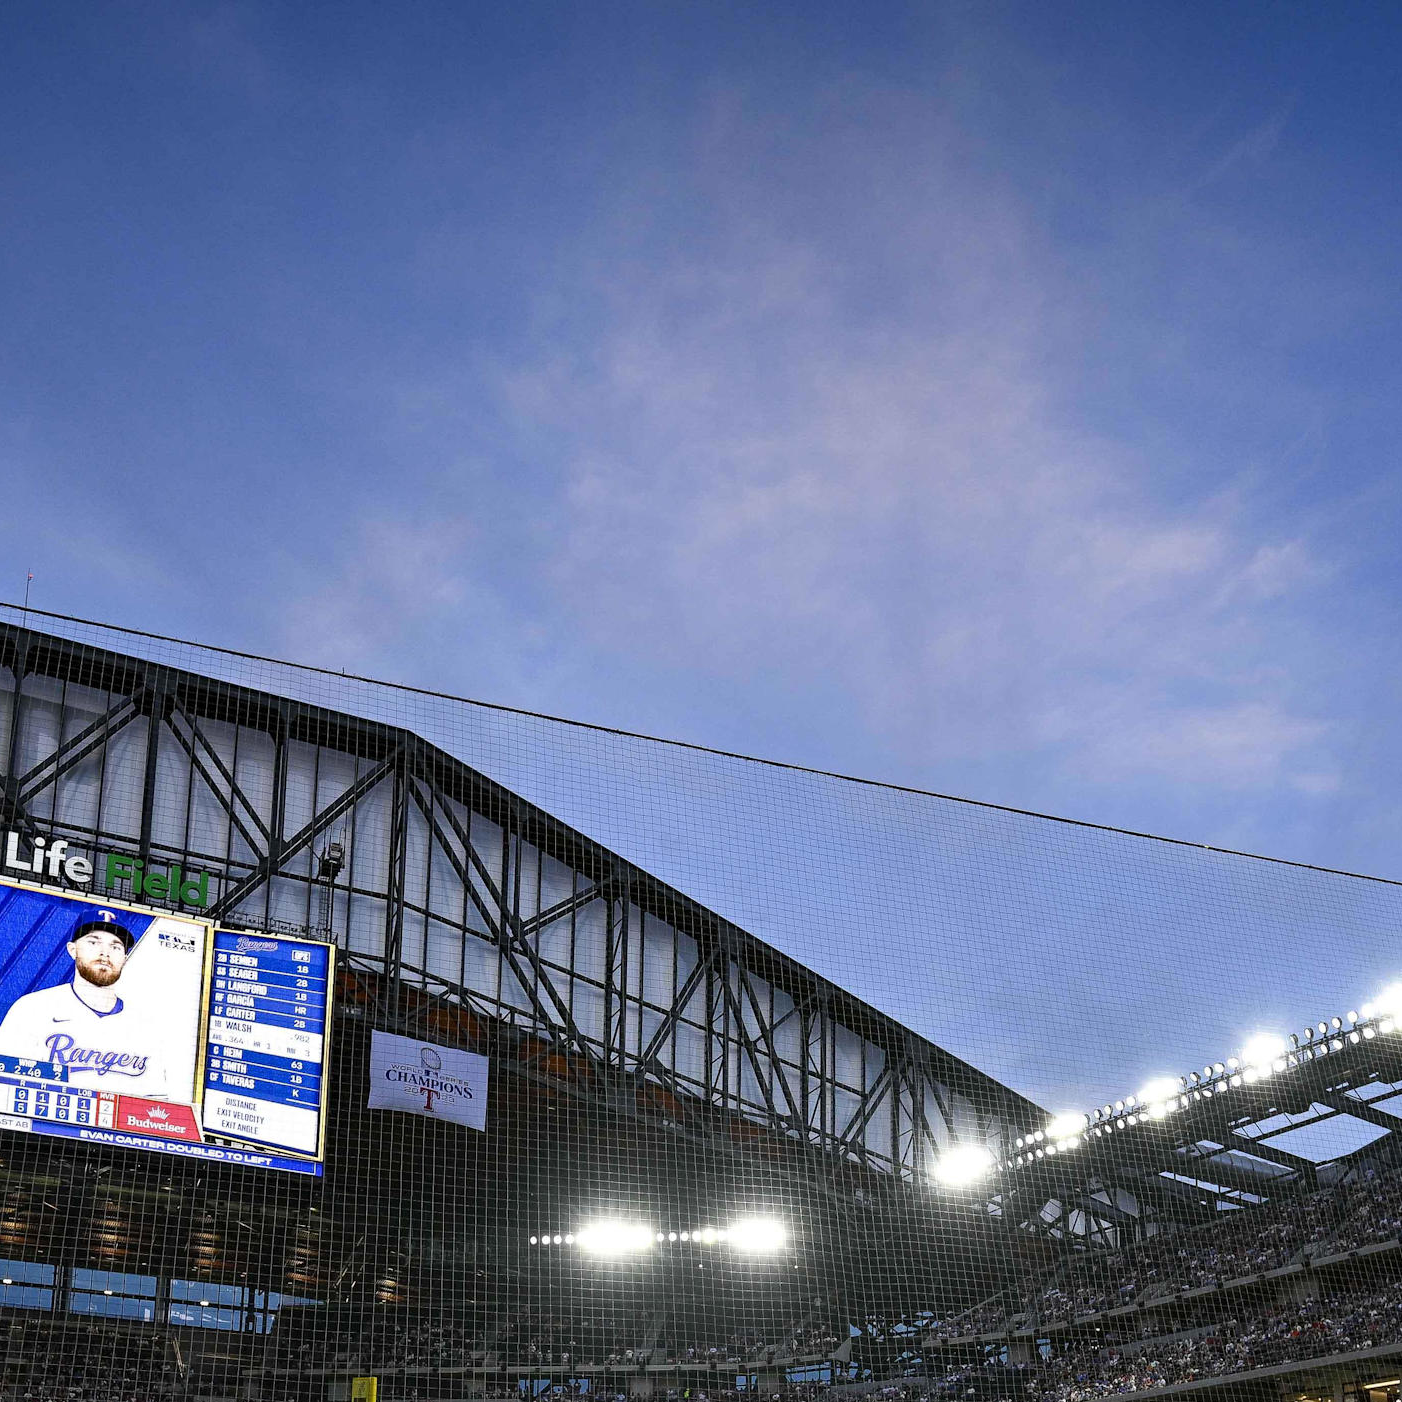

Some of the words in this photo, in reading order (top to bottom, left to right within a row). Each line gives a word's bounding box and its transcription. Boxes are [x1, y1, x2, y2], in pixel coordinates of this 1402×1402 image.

[5, 830, 94, 883] Life
[105, 853, 209, 908] Field
[158, 940, 195, 953] TEXAS
[229, 968, 258, 981] SEAGER
[226, 1006, 256, 1020] CARTER
[226, 1021, 252, 1033] WALSH
[46, 1033, 150, 1077] Rangers
[14, 1065, 41, 1078] 2.40
[222, 1061, 247, 1074] SMITH
[222, 1073, 255, 1089] TAVERAS
[385, 1069, 473, 1099] CHAMPIONS
[225, 1098, 257, 1112] DISTANCE
[217, 1108, 232, 1118] EXIT
[233, 1111, 265, 1125] VELOCITY
[15, 1120, 29, 1129] AB
[127, 1115, 186, 1134] Budweiser
[221, 1120, 236, 1129] EXIT
[237, 1123, 259, 1135] ANGLE
[80, 1130, 114, 1143] EVAN
[115, 1135, 166, 1150] CARTER
[166, 1142, 225, 1159] DOUBLED
[225, 1151, 243, 1162] TO
[244, 1153, 273, 1166] LEFT
